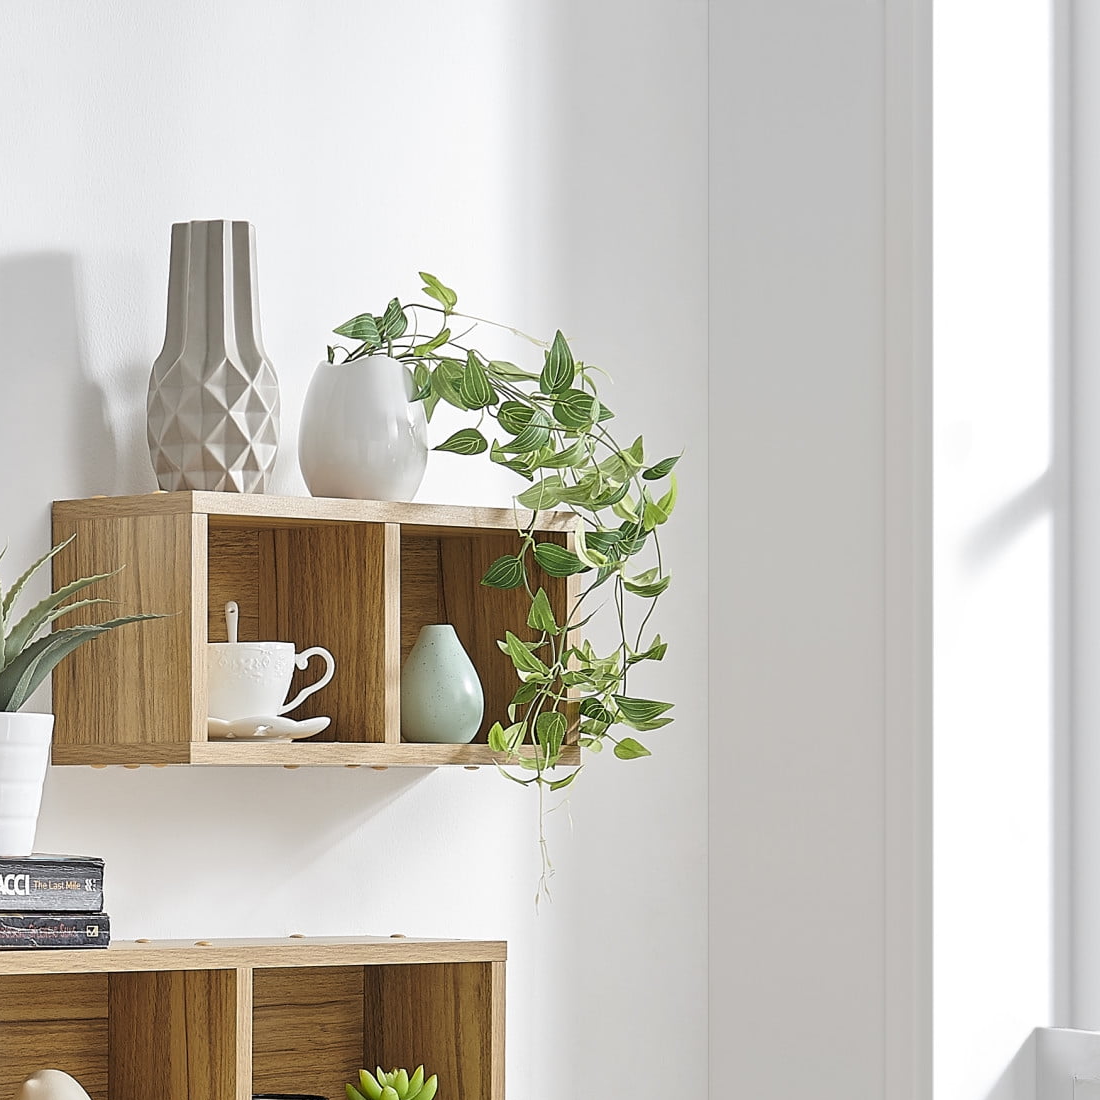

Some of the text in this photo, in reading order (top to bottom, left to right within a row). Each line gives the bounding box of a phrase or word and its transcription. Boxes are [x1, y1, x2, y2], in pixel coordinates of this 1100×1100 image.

[34, 880, 48, 890] The
[48, 880, 65, 890] Last
[65, 880, 81, 890] Mile
